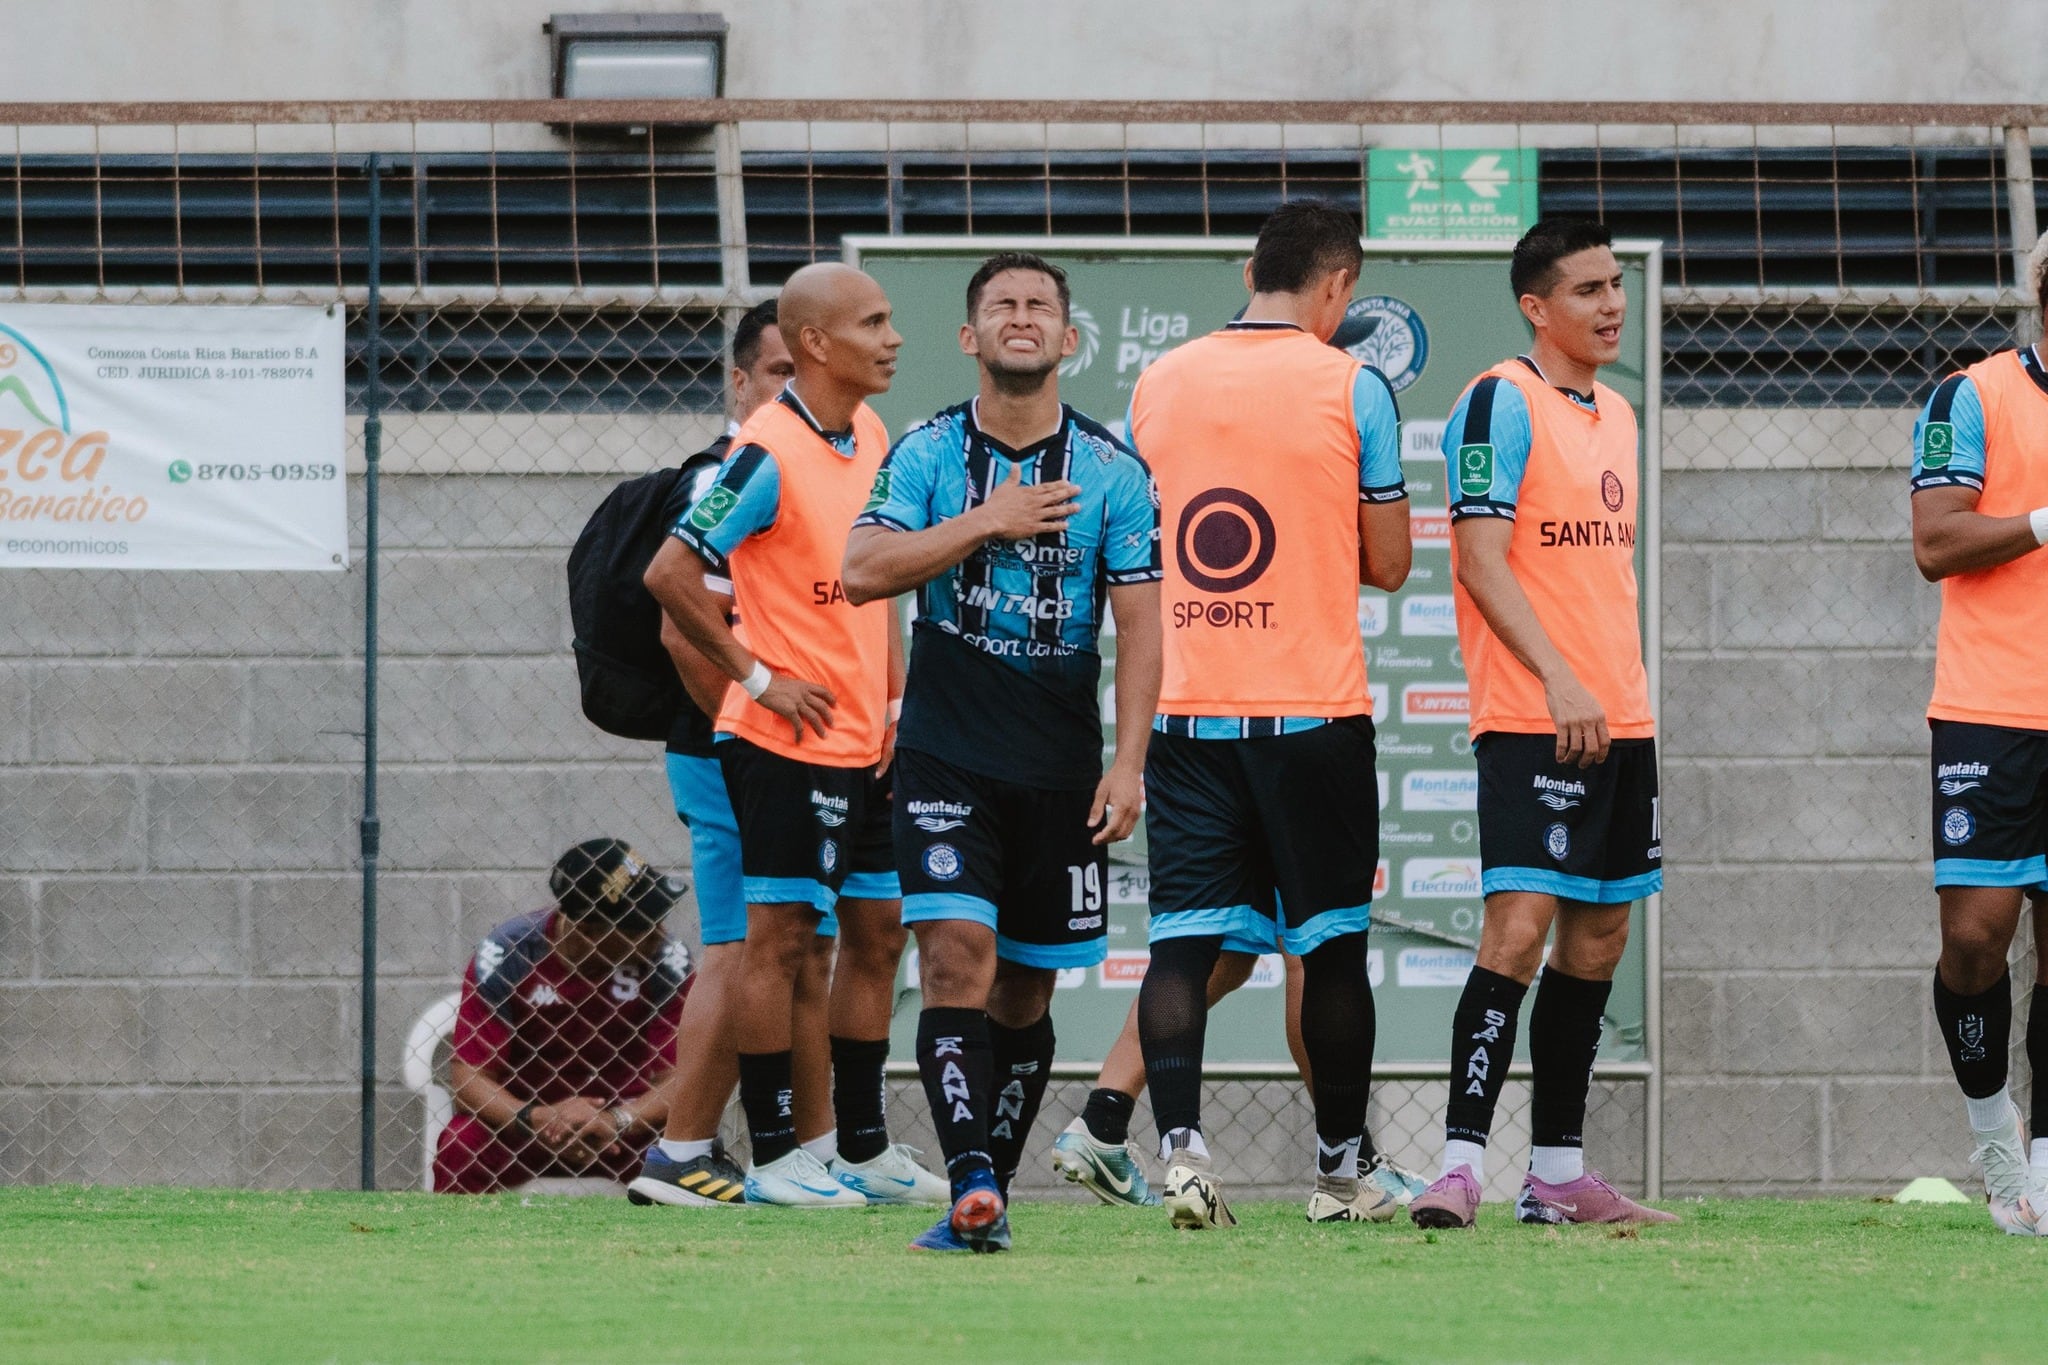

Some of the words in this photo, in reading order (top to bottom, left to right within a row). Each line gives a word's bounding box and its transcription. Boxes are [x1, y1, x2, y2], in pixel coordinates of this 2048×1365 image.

[1410, 203, 1464, 214] RUTA
[1469, 203, 1496, 214] DE
[1347, 299, 1385, 317] SANTA
[1386, 301, 1411, 320] ANA
[1121, 307, 1189, 345] Liga
[87, 346, 147, 360] Conozca
[151, 346, 191, 360] Costa
[195, 347, 227, 360] Rica
[230, 347, 291, 360] Baratico
[137, 366, 211, 380] JURIDICA
[215, 367, 314, 380] 3-101-782074
[197, 463, 338, 482] 8705-0959
[1540, 521, 1615, 547] SANTA
[7, 537, 129, 555] economicos
[965, 584, 1074, 620] INTACO
[1377, 647, 1399, 658] Liga
[1376, 657, 1433, 668] Promerica
[1379, 733, 1400, 744] Liga
[1375, 744, 1434, 755] Promerica
[1409, 777, 1477, 793] Montaña
[907, 799, 973, 816] Montaña
[1067, 861, 1102, 913] 19
[1411, 880, 1480, 893] Electrolit
